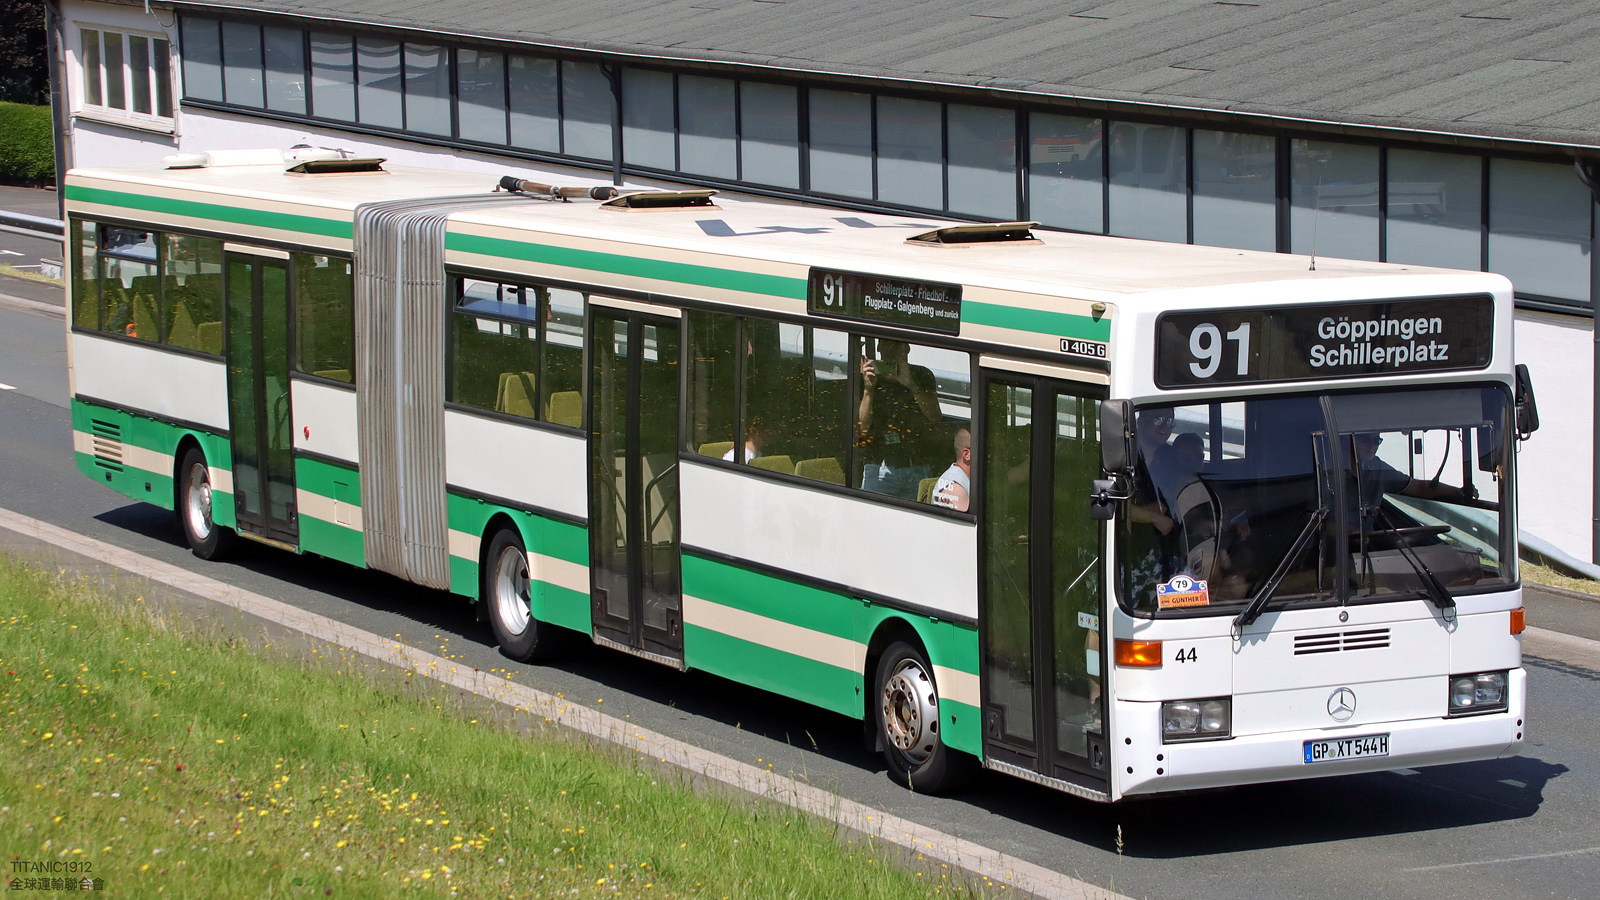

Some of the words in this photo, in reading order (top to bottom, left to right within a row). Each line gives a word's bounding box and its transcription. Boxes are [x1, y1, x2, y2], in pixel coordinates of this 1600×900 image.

[823, 274, 844, 307] 91
[875, 282, 914, 298] Schillerplatz
[918, 287, 945, 302] Friedhof
[864, 295, 893, 310] Flugplatz
[897, 300, 934, 318] Galgenberg
[944, 311, 959, 319] zurück
[1318, 314, 1443, 342] Göppingen
[1071, 342, 1095, 355] 405
[1097, 344, 1105, 357] G
[1189, 322, 1250, 379] 91
[1309, 341, 1449, 368] Schillerplatz
[1175, 580, 1188, 588] 79
[1175, 647, 1198, 663] 44
[1312, 743, 1329, 759] GP
